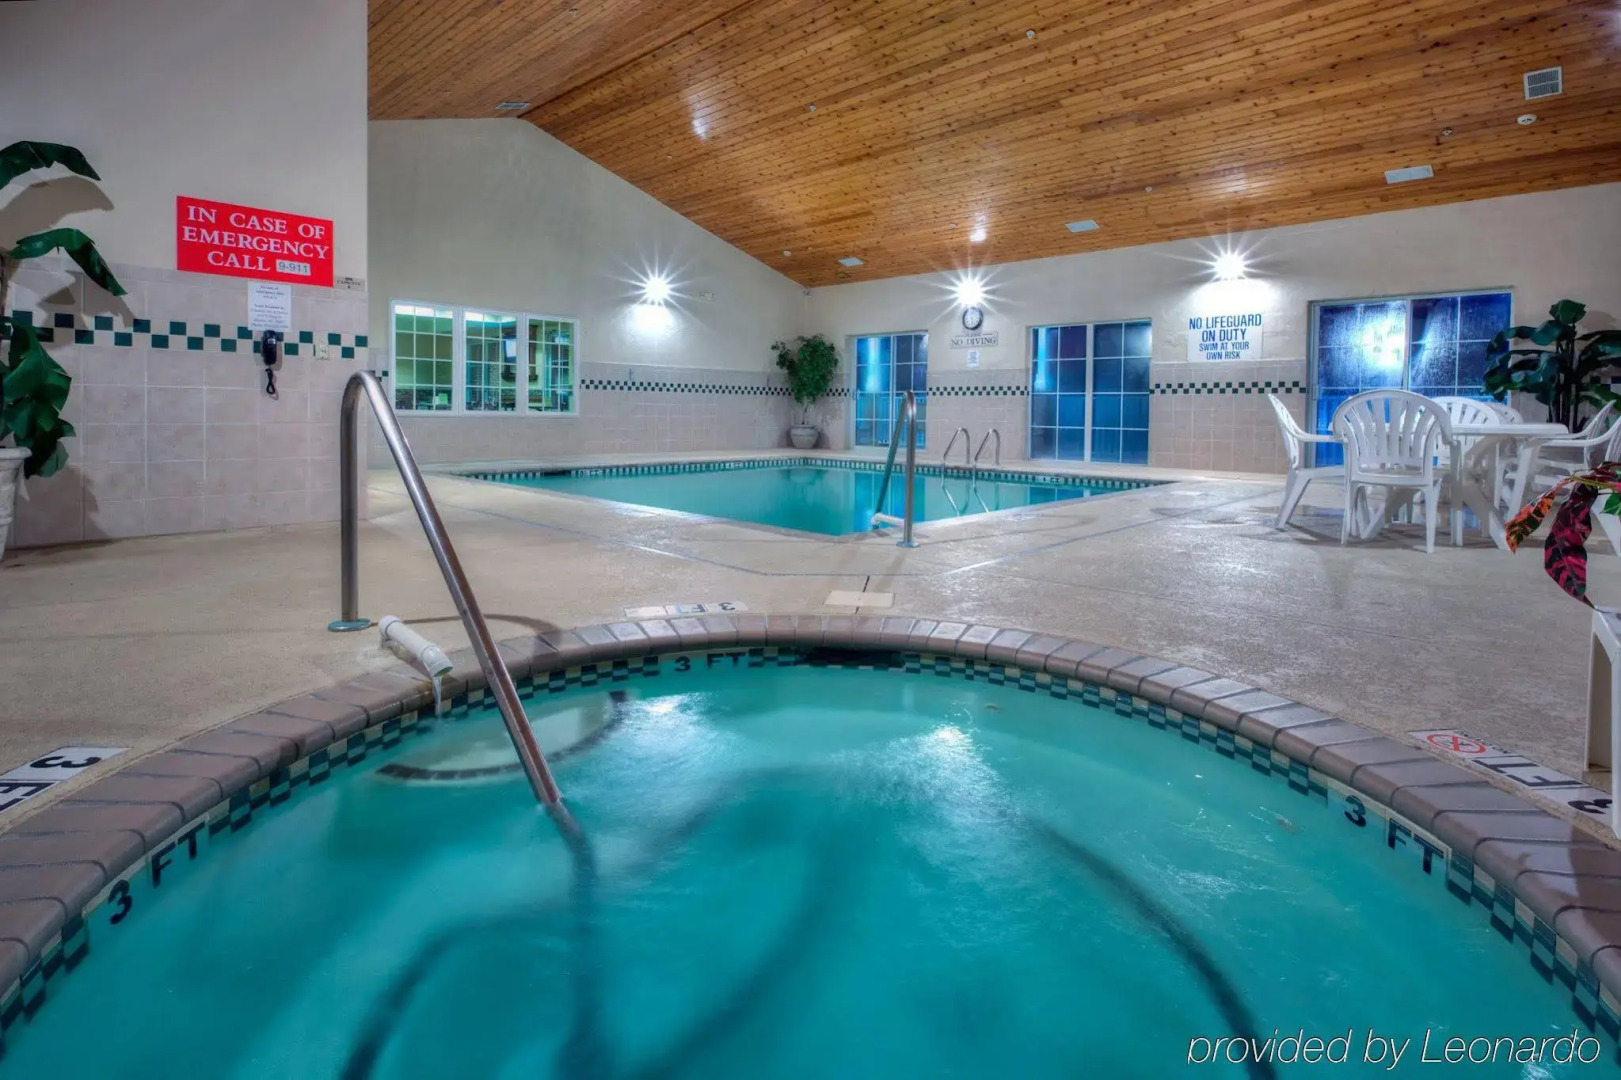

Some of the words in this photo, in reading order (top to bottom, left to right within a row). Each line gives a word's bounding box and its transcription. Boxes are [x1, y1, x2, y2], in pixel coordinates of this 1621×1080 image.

[187, 205, 217, 224] IN
[229, 212, 287, 234] CASE
[298, 223, 325, 240] OF
[182, 226, 329, 259] EMERGENCY
[207, 251, 271, 272] CALL
[278, 261, 308, 274] 9-911
[1189, 317, 1203, 330] NO
[1206, 313, 1262, 329] LIFEGUARD
[966, 336, 996, 345] DIVING
[1201, 330, 1215, 342] ON
[1219, 328, 1247, 341] DUTY
[1199, 342, 1218, 351] SWIM
[1220, 342, 1229, 351] AT
[1231, 341, 1250, 350] YOUR
[1206, 351, 1222, 360] OWN
[1224, 351, 1241, 360] RISK
[718, 602, 736, 611] 3
[674, 656, 691, 672] 3
[706, 651, 746, 670] FT
[29, 755, 102, 769] 3
[1472, 758, 1585, 787] FT
[1344, 794, 1367, 827] 3
[1387, 817, 1445, 875] FT
[108, 879, 133, 925] 3
[151, 821, 206, 888] FT
